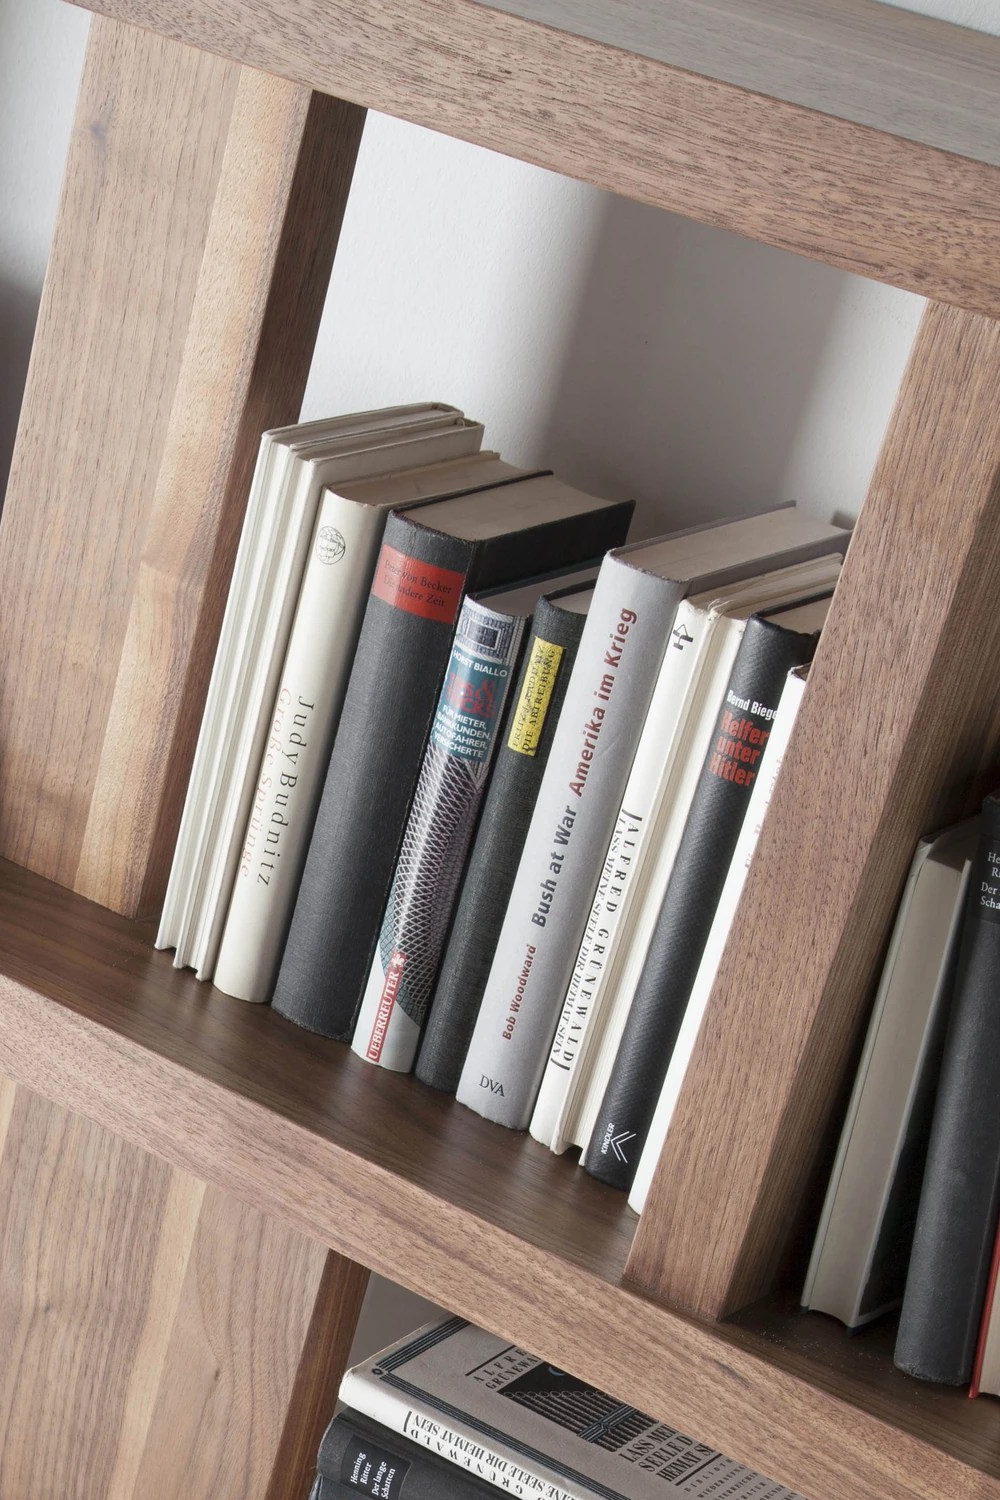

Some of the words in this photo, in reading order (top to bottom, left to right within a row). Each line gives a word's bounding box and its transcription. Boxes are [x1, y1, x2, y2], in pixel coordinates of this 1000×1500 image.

[402, 569, 419, 584] von
[420, 574, 452, 593] Becker
[426, 592, 446, 608] Zeit
[604, 607, 638, 669] Krieg
[473, 659, 508, 677] BIALLO
[594, 673, 616, 702] im
[726, 689, 751, 711] Bernd
[281, 695, 315, 766] Judy
[720, 711, 770, 746] Helfer
[568, 706, 606, 797] Amerika
[717, 736, 761, 765] unter
[709, 753, 756, 787] Hitler
[257, 770, 298, 886] Budnitz
[554, 805, 578, 847] War
[549, 850, 565, 876] at
[606, 822, 640, 912] ALFRED
[531, 878, 557, 928] Bush
[981, 882, 998, 895] Der
[509, 943, 538, 1013] Woodward
[562, 928, 609, 1062] GRÜNEWALD
[367, 971, 400, 1062] UEBERREUTER
[502, 1014, 517, 1041] Bob
[479, 1075, 505, 1097] DVA
[600, 1122, 615, 1155] KINDLER
[414, 1414, 439, 1437] SEIN
[411, 1428, 523, 1494] GRÜNEWALD
[437, 1432, 485, 1462] HEIMAT
[485, 1453, 508, 1472] DIR
[639, 1441, 686, 1472] SEELE
[350, 1452, 367, 1485] Henning
[360, 1462, 373, 1485] Ritter
[371, 1478, 381, 1496] Der
[376, 1461, 388, 1482] lange
[510, 1465, 546, 1492] SEELE
[657, 1451, 702, 1482] HEIMAT
[380, 1468, 396, 1500] Schatten
